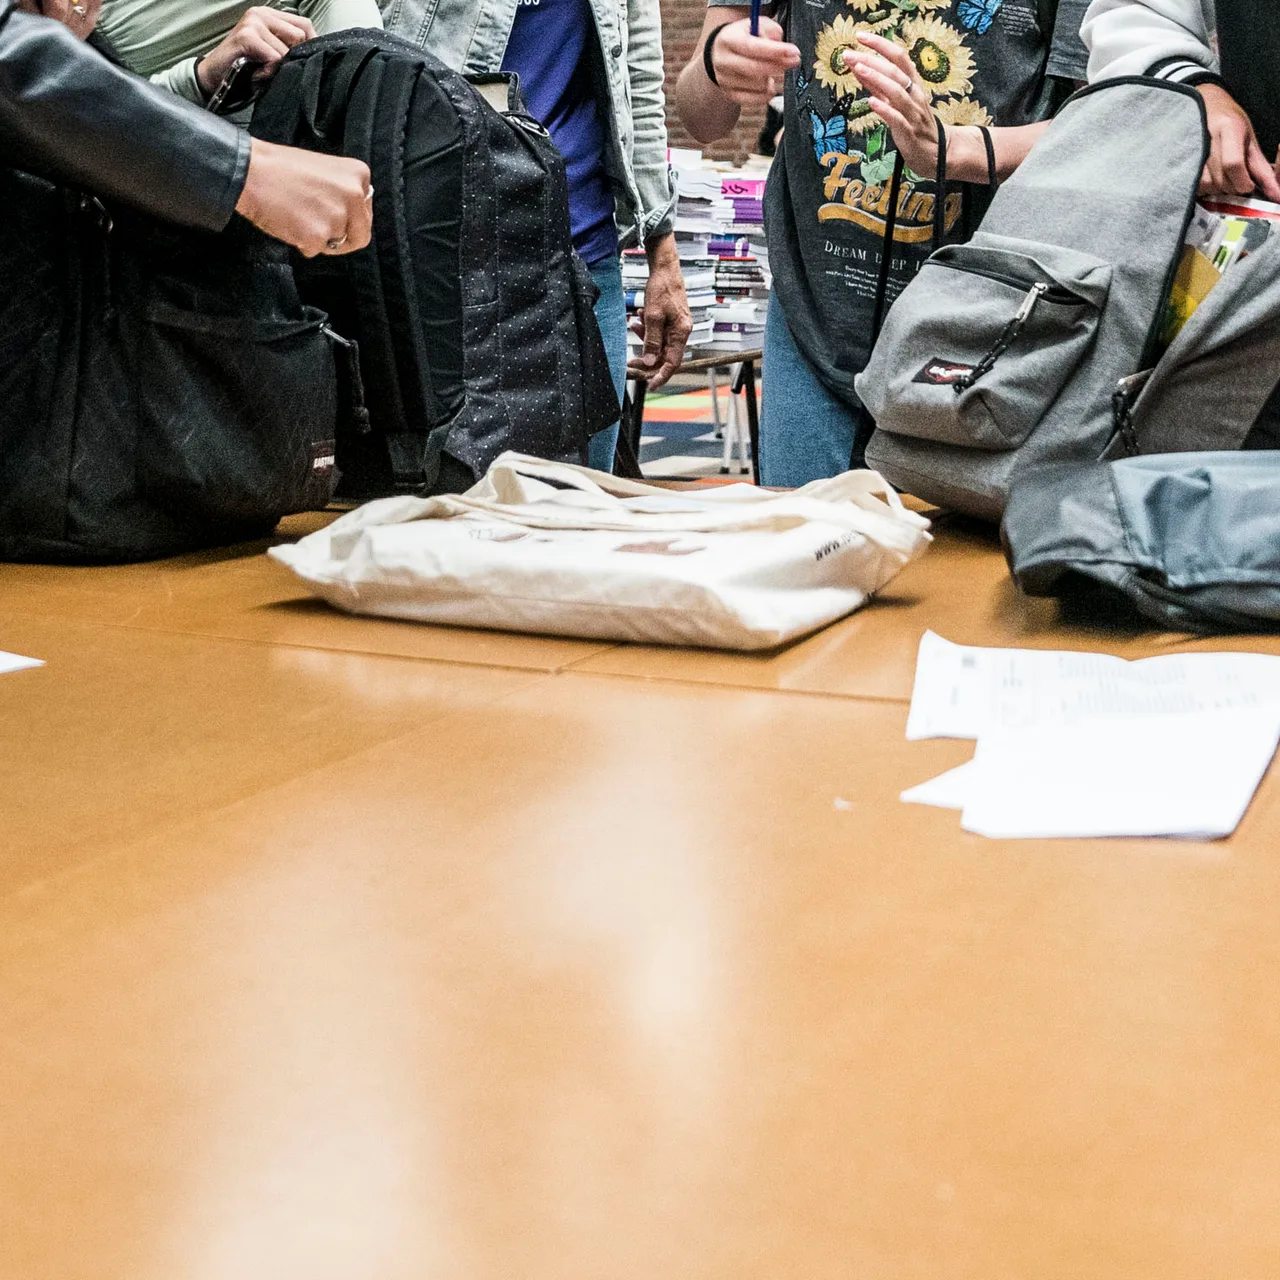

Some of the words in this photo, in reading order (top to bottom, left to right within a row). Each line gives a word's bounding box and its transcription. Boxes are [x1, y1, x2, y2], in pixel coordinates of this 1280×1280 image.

[821, 151, 963, 234] Feeling
[825, 241, 867, 261] DREAM
[875, 252, 907, 271] DEP
